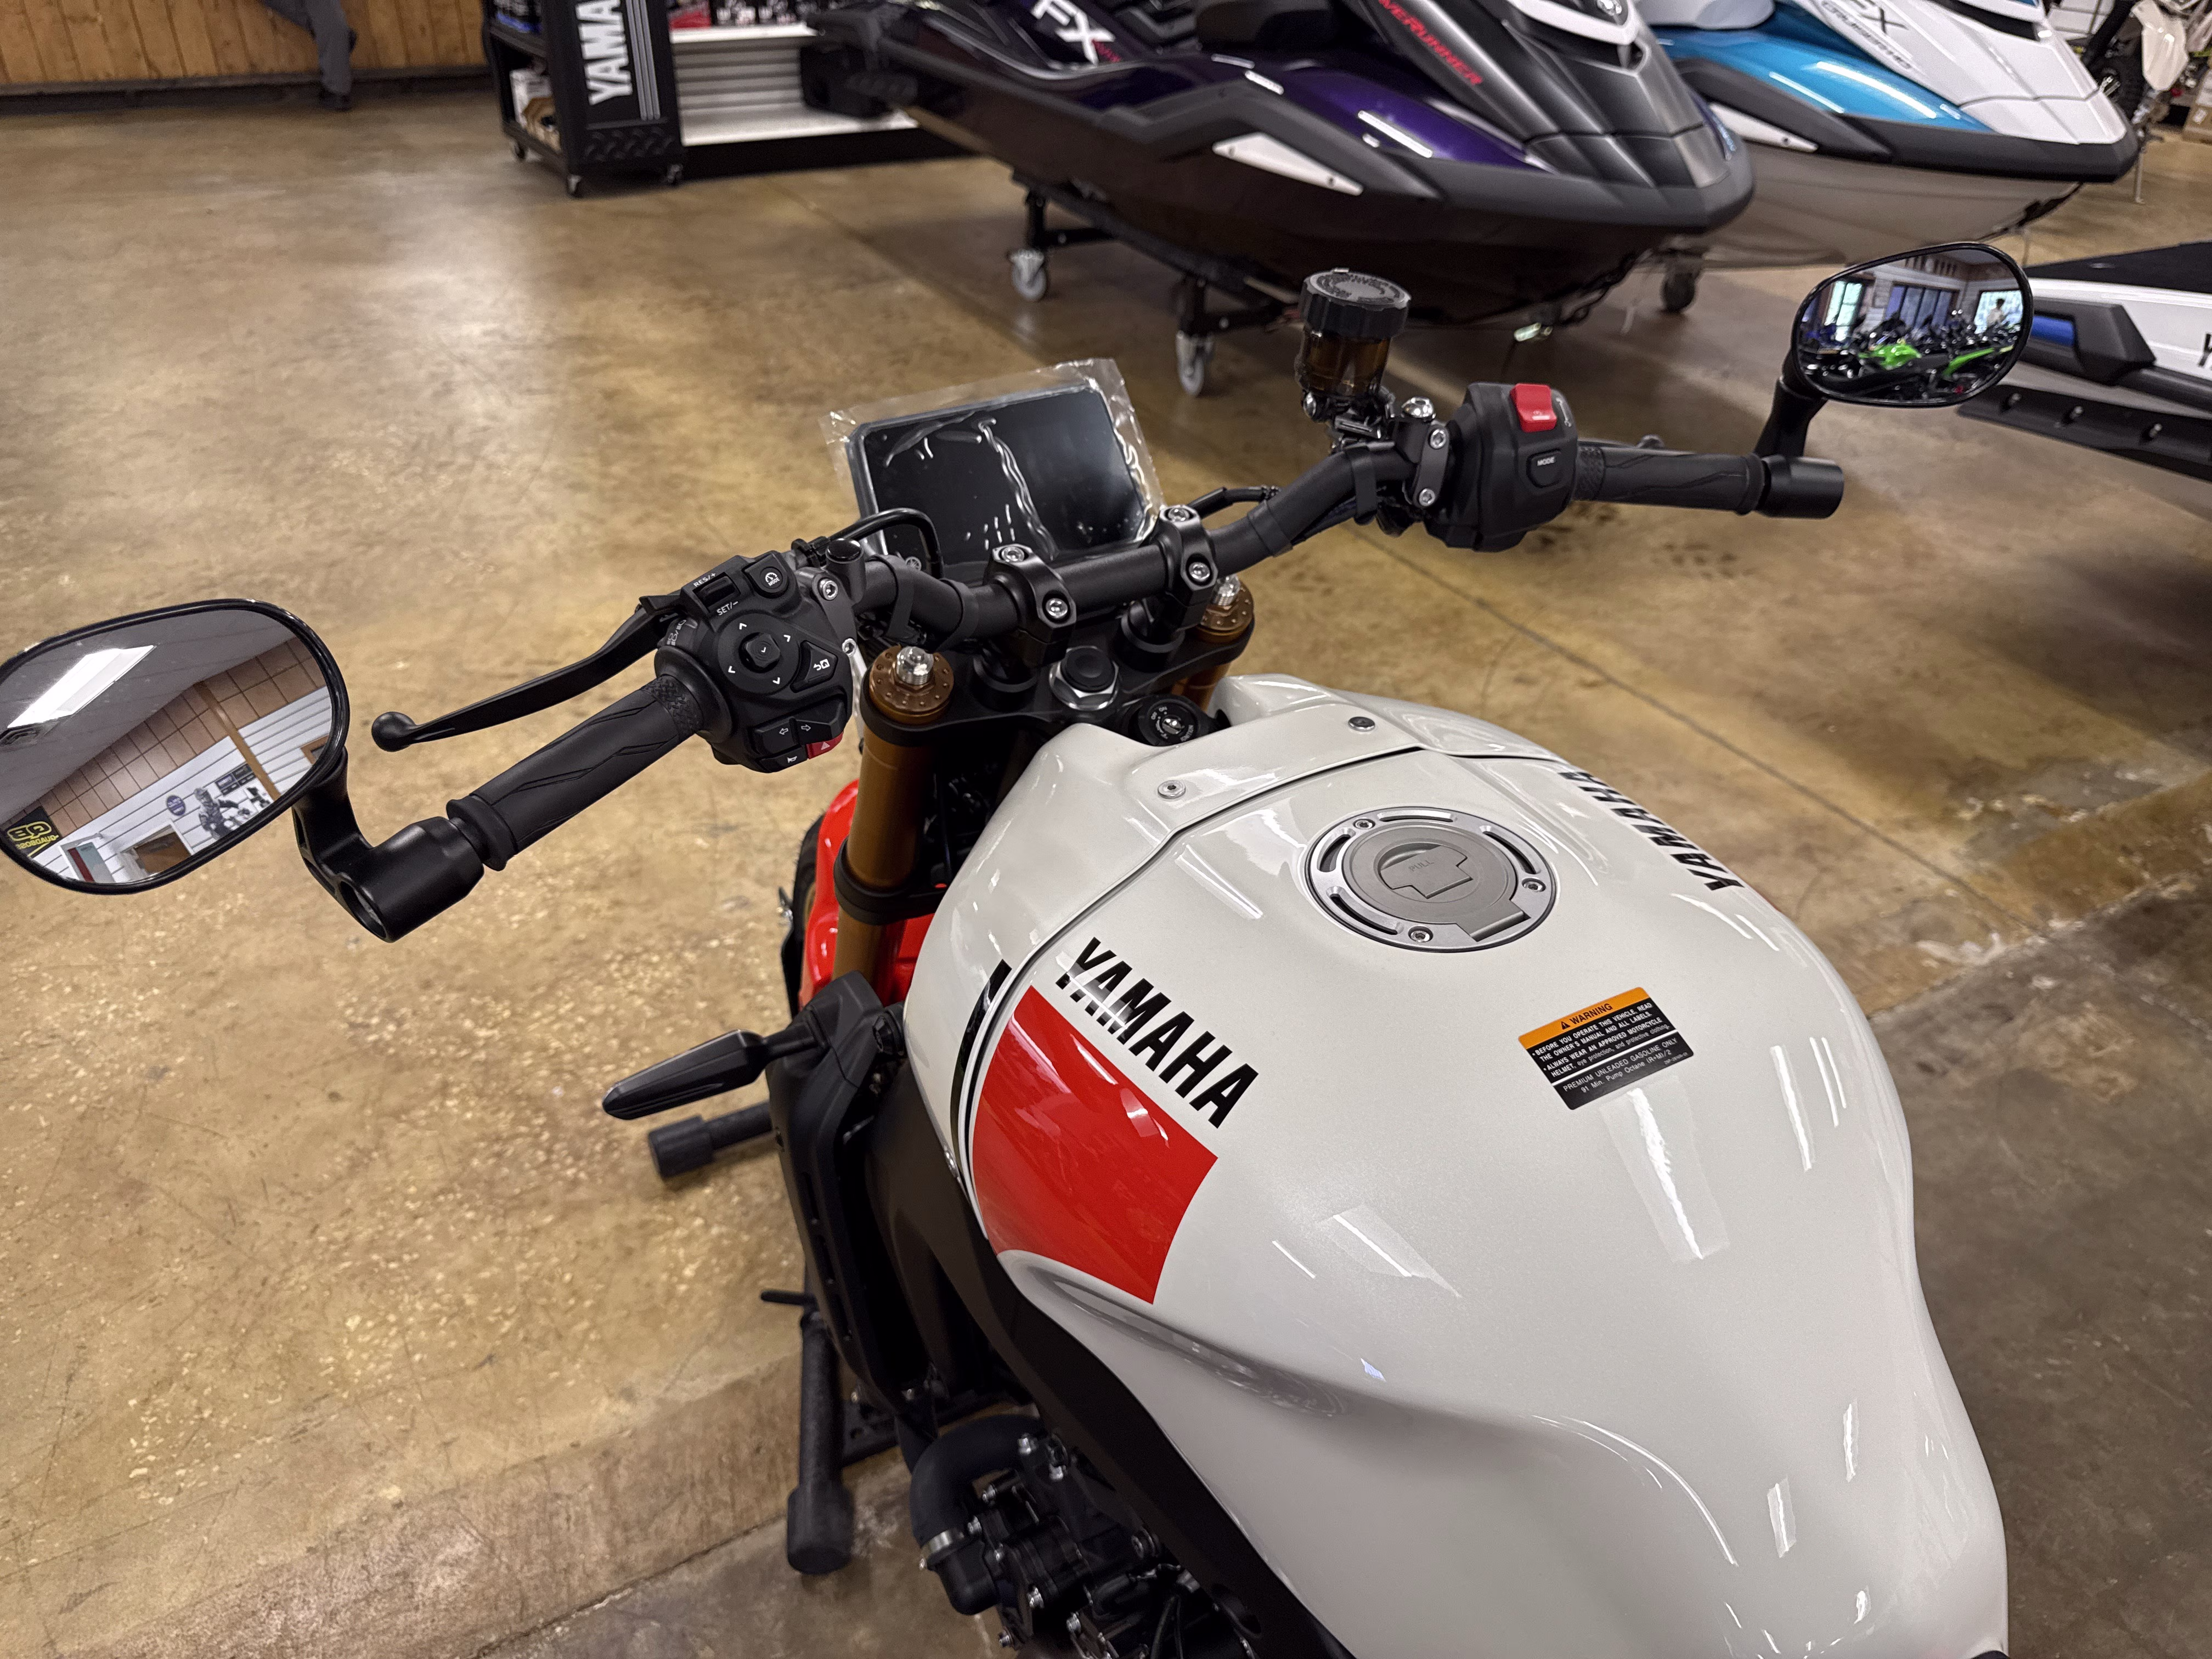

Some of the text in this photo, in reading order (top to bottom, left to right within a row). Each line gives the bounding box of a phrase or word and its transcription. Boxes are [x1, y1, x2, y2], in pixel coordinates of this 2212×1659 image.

[1030, 0, 1116, 65] FX
[1378, 0, 1483, 84] VERUNNER
[1537, 456, 1555, 466] MODE
[693, 573, 716, 588] RES/+
[768, 577, 780, 586] MODE
[716, 601, 738, 616] SET/-
[1558, 772, 1745, 891] YAMAHA
[1408, 860, 1435, 872] PULL
[1056, 936, 1259, 1128] YAMAHA
[1535, 1041, 1559, 1056] BEFORE
[1559, 1035, 1572, 1045] YOU
[1572, 1024, 1599, 1039] OPERATE
[1598, 1018, 1612, 1028] THIS
[1637, 1002, 1653, 1012] READ
[1539, 1053, 1553, 1062] THE
[1553, 1041, 1581, 1056] OWNER'S
[1580, 1031, 1605, 1044] MANUAL
[1605, 1025, 1617, 1034] AND
[1629, 1011, 1652, 1023] LABELS.
[1569, 1003, 1613, 1025] WARNING
[1547, 1017, 1662, 1071] ALWAYS WEAR AN APPROVED MOTORCYCLE
[1562, 1074, 1594, 1092] PREMIUM
[1594, 1058, 1629, 1077] UNLEADED
[1630, 1044, 1661, 1062] GASOLINE
[1662, 1037, 1678, 1048] ONLY
[1615, 1041, 1626, 1049] and
[1626, 1032, 1650, 1046] protective
[1581, 1085, 1590, 1093] 91
[1590, 1080, 1605, 1089] Min.
[1605, 1071, 1623, 1082] Pump
[1624, 1060, 1645, 1073] Octane
[1646, 1048, 1672, 1064] (R+M)/2
